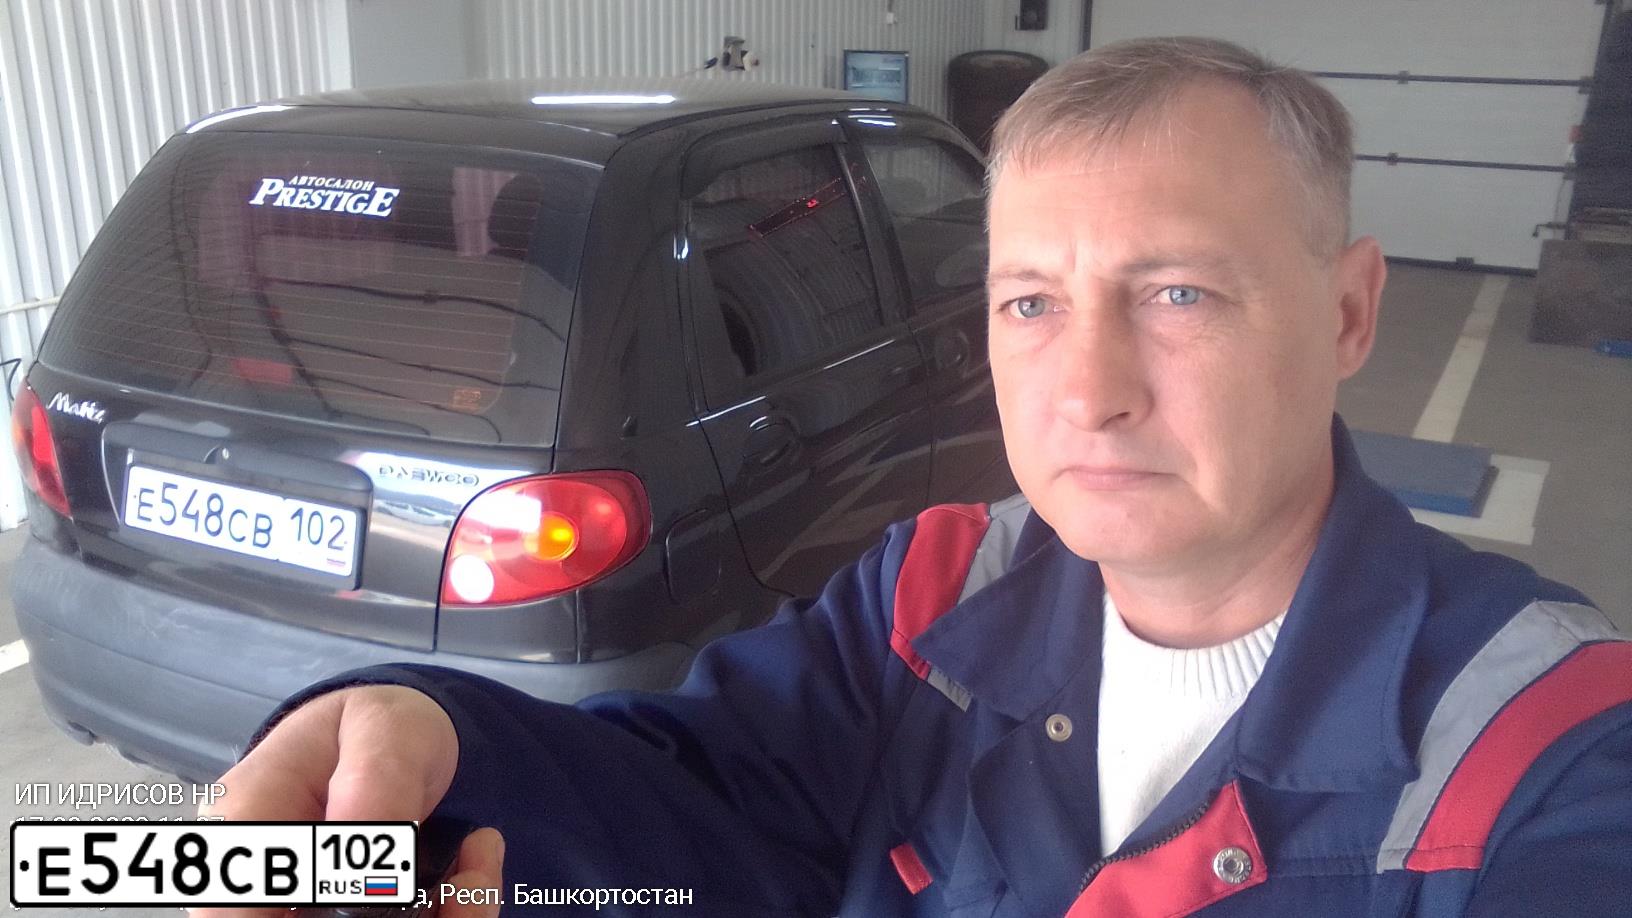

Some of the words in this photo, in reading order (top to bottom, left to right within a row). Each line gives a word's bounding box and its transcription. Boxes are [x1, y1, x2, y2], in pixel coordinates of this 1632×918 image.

[249, 178, 400, 217] PRESTIGE
[288, 175, 375, 192] АВТОСАЛОН
[136, 481, 273, 549] Е548СВ
[290, 507, 346, 551] 102
